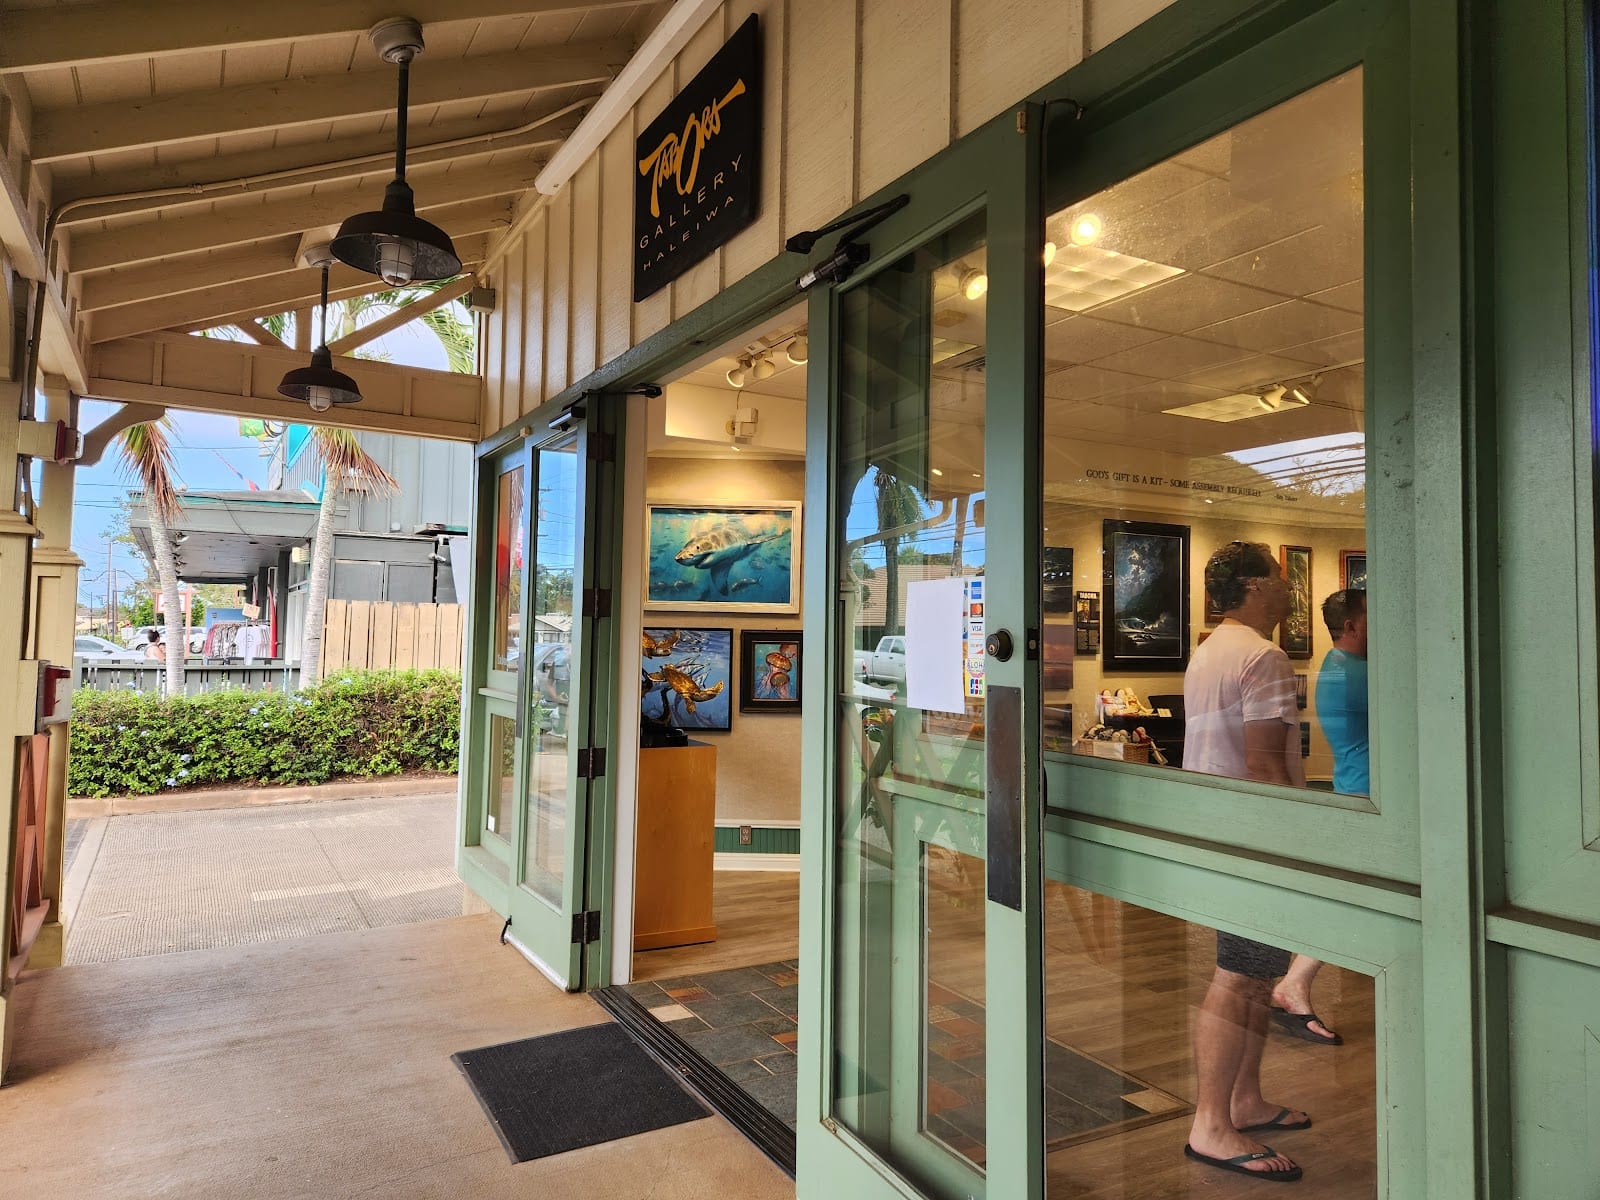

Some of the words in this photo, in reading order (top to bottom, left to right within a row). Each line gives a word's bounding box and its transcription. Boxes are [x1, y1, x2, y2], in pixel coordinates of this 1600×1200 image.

[640, 154, 742, 249] GALLERY
[643, 197, 735, 271] HALEIWA
[1086, 469, 1109, 479] GOD'S
[1113, 472, 1130, 482] GIFT
[1132, 475, 1139, 483] IS
[1142, 475, 1147, 484] A
[1170, 478, 1189, 489] SOME
